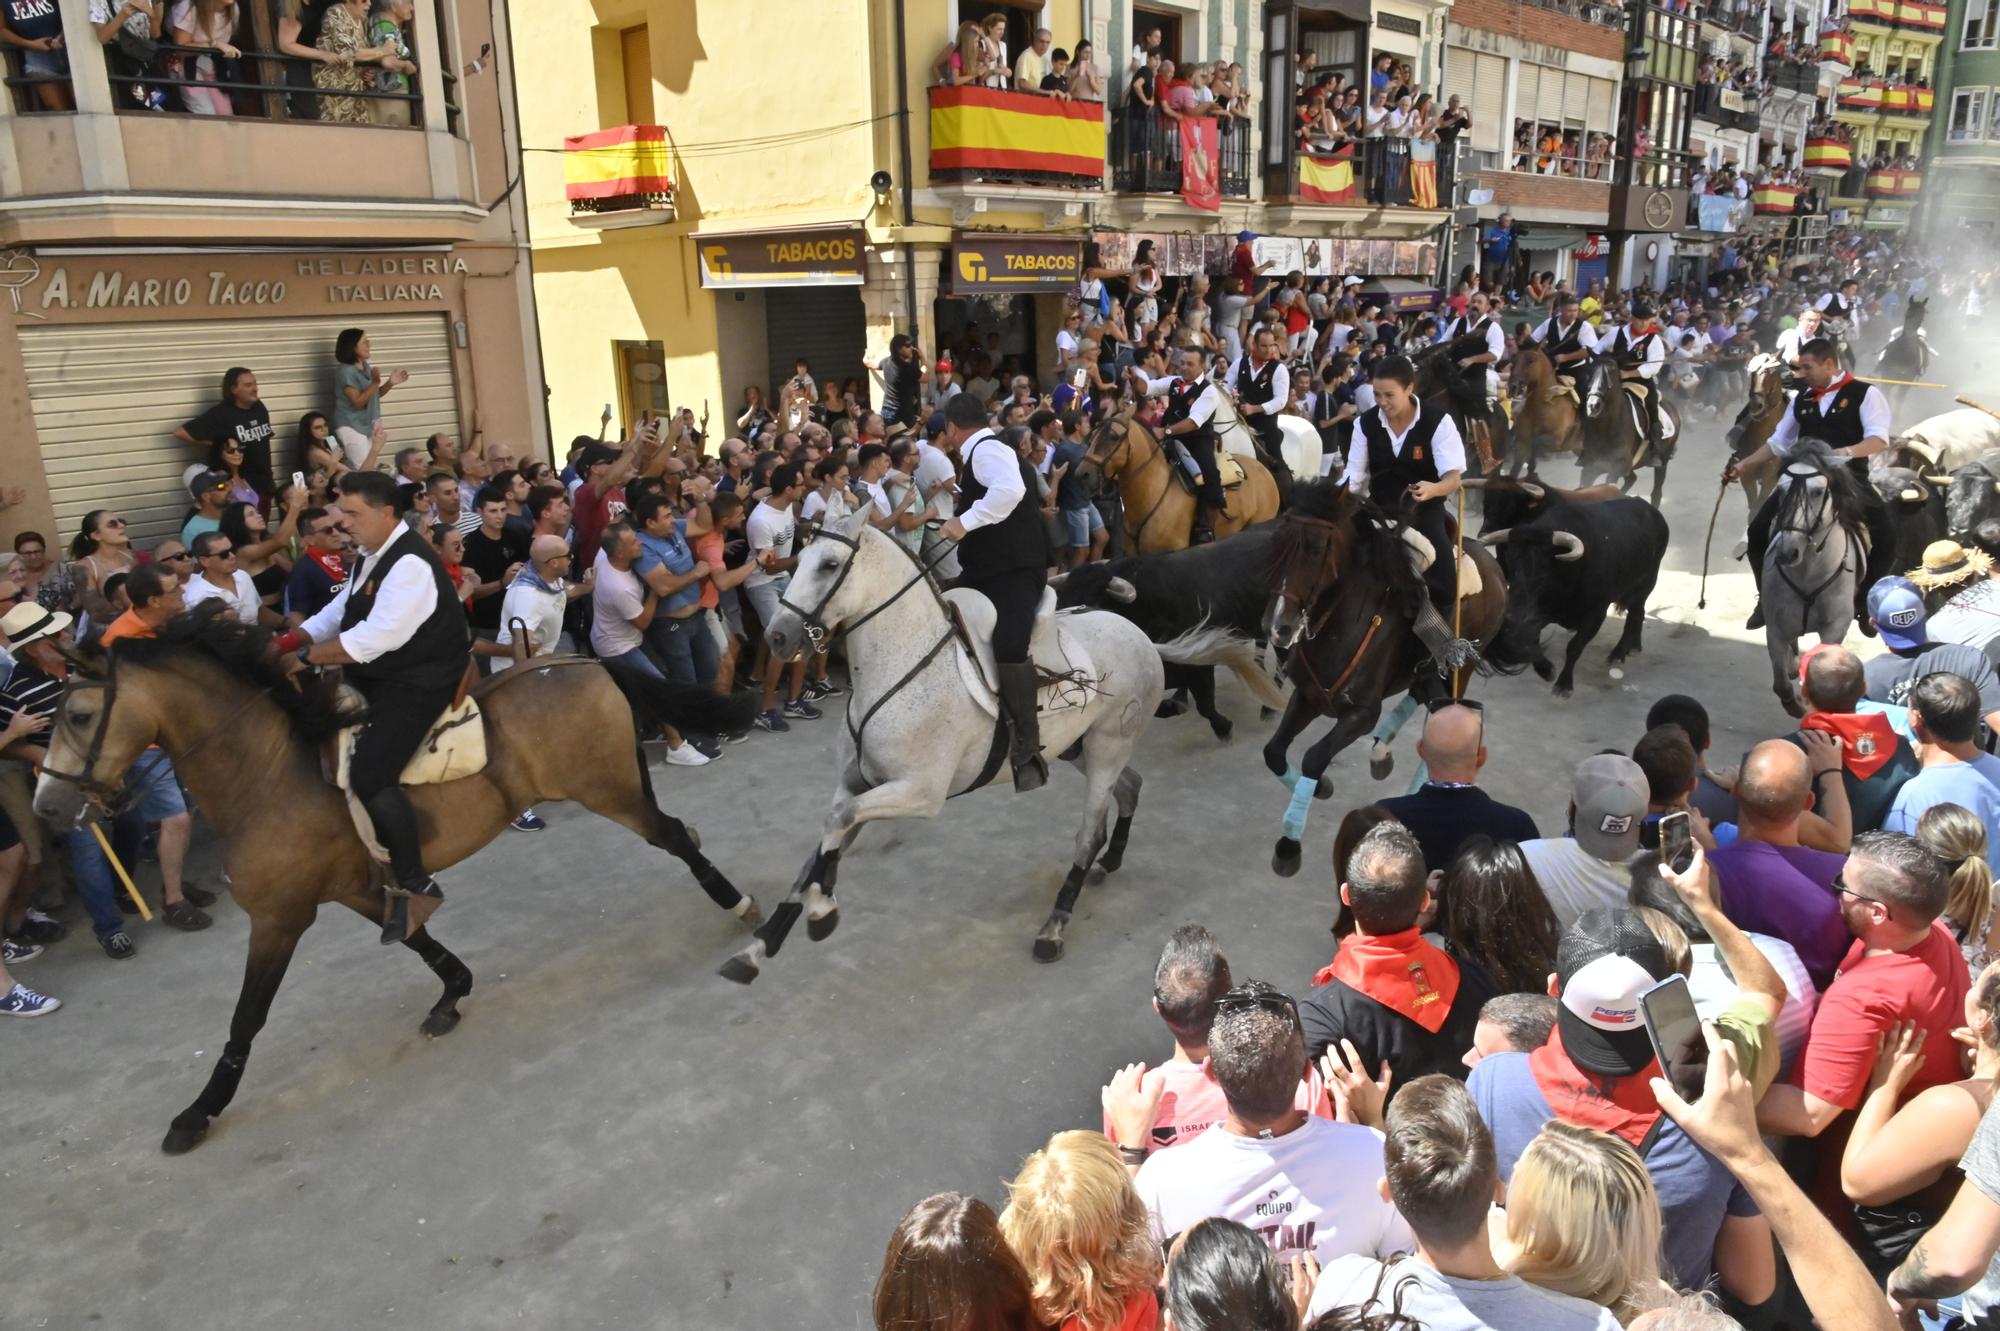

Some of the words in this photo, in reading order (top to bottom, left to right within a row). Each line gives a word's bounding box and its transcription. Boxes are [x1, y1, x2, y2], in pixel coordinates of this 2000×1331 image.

[11, 0, 55, 20] JEANS
[766, 239, 856, 263] TABACOS
[1004, 254, 1076, 270] TABACOS
[40, 268, 78, 308] A.
[328, 283, 444, 302] ITALIANA
[1893, 610, 1915, 625] DEUS
[1595, 1006, 1637, 1017] PEPSI
[1256, 1201, 1292, 1216] EQUIPO
